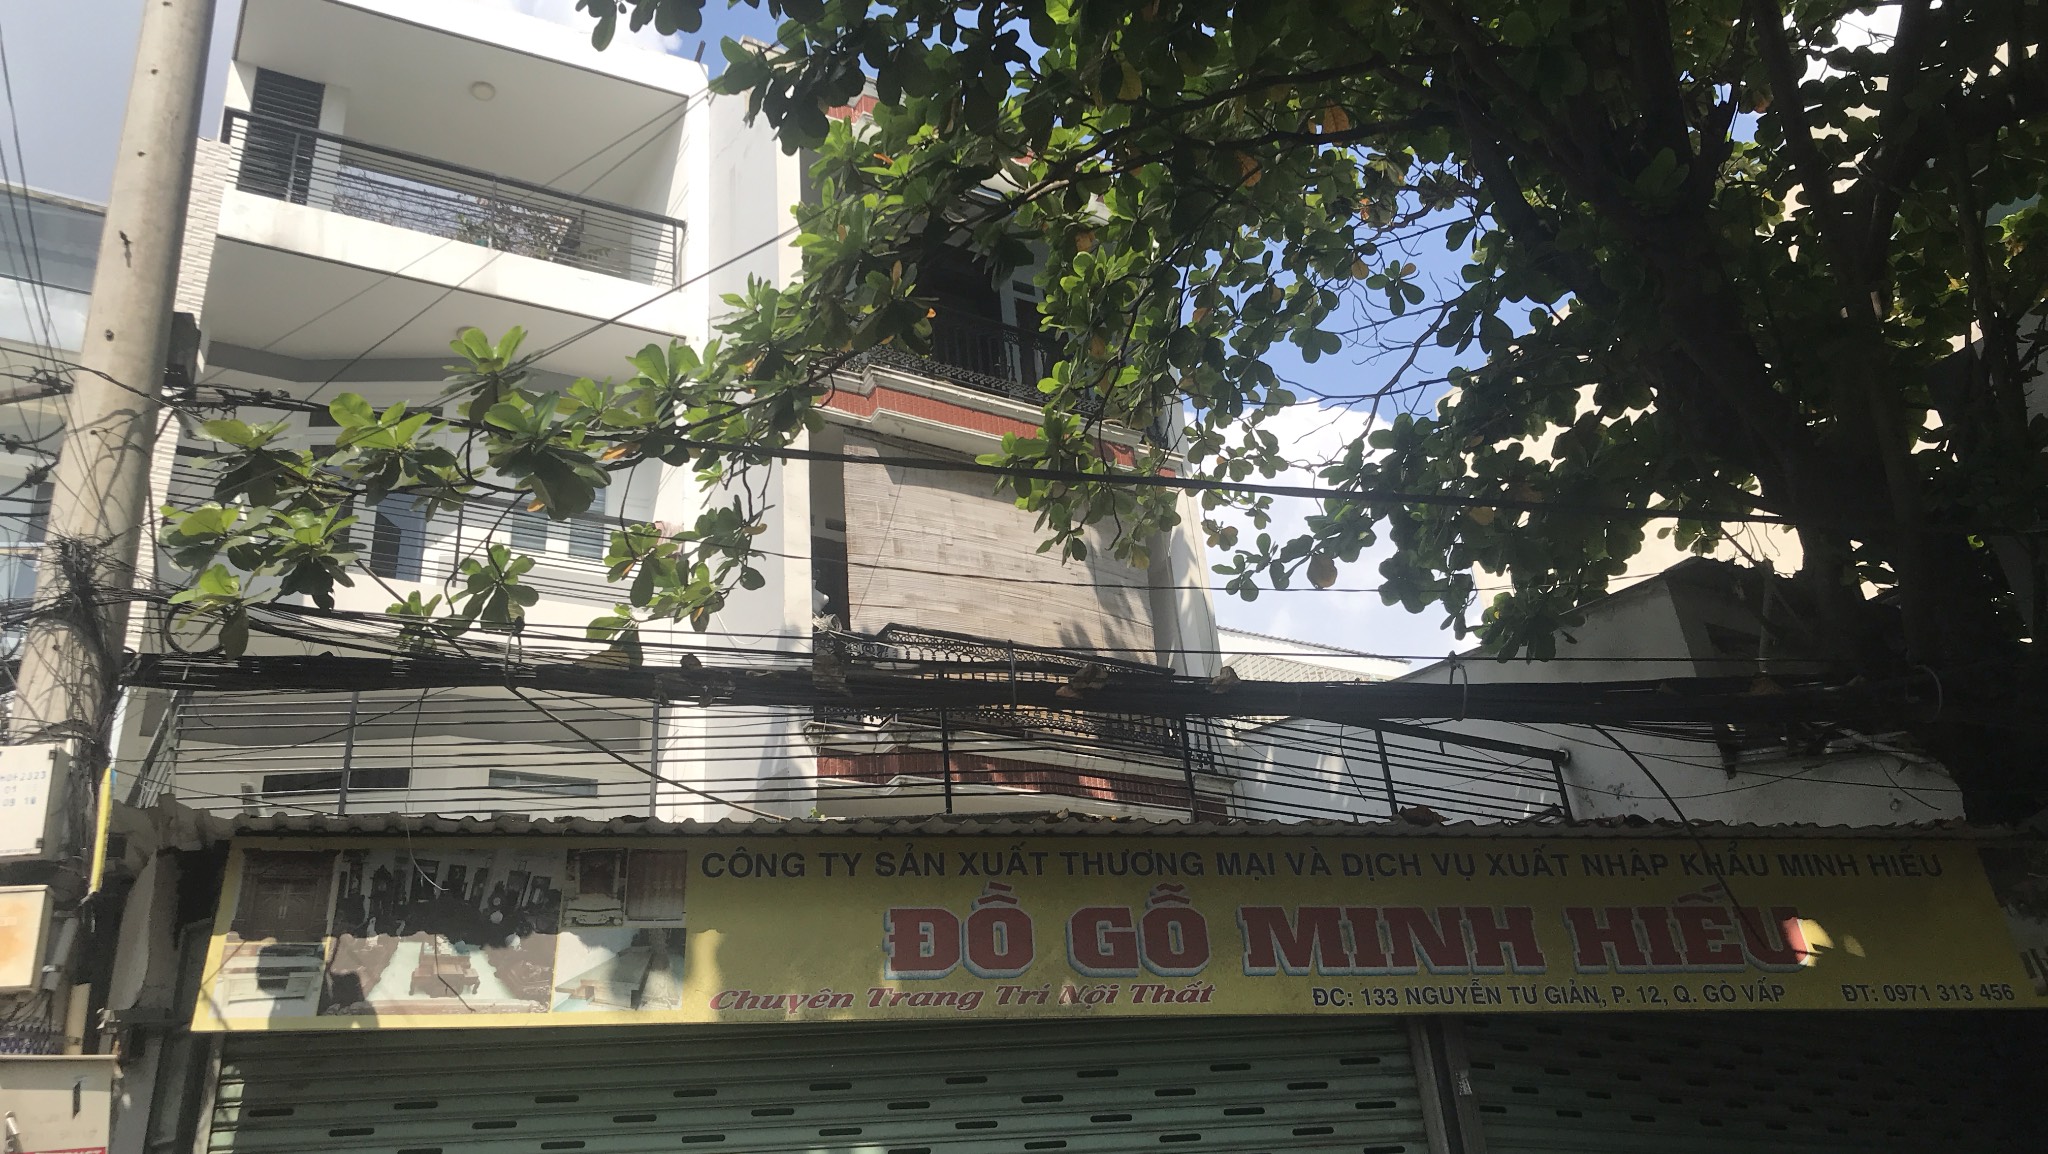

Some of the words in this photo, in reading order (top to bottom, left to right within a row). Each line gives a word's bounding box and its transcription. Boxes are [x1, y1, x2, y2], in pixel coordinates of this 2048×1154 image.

[702, 846, 805, 878] CÔNG
[818, 852, 862, 877] TY
[875, 842, 946, 877] SẢN
[957, 842, 1049, 876] XUẤT
[1059, 848, 1205, 876] THƯƠNG
[1216, 851, 1275, 881] MẠI
[1284, 845, 1332, 876] VÀ
[1341, 852, 1422, 881] DỊCH
[1430, 853, 1476, 881] VỤ
[1485, 844, 1569, 877] XUẤT
[1581, 847, 1669, 881] NHẬP
[1680, 841, 1770, 877] KHẨU
[1777, 853, 1860, 877] MINH
[1867, 844, 1944, 877] HIẾU
[882, 881, 1035, 979] ĐỒ
[1066, 881, 1211, 978] GỖ
[1236, 905, 1547, 976] MINH
[1562, 883, 1808, 974] HIẾU
[709, 988, 855, 1014] Chuyên
[866, 986, 986, 1011] Trang
[996, 984, 1051, 1006] Trí
[1059, 985, 1117, 1011] Nội
[1130, 982, 1216, 1005] Thất
[1312, 987, 1354, 1007] ĐC:
[1360, 987, 1399, 1006] 133
[1404, 979, 1502, 1006] NGUYỄN
[1506, 984, 1538, 1005] TƯ
[1544, 978, 1607, 1008] GIẢN,
[1611, 985, 1631, 1004] P.
[1636, 985, 1668, 1007] 12,
[1673, 984, 1697, 1005] Q.
[1703, 980, 1737, 1003] GÒ
[1742, 976, 1786, 1003] VẤP
[1843, 984, 1879, 1003] ĐT:
[1882, 983, 1932, 1002] 0971
[1938, 983, 1974, 1002] 313
[1980, 983, 2016, 1002] 456
